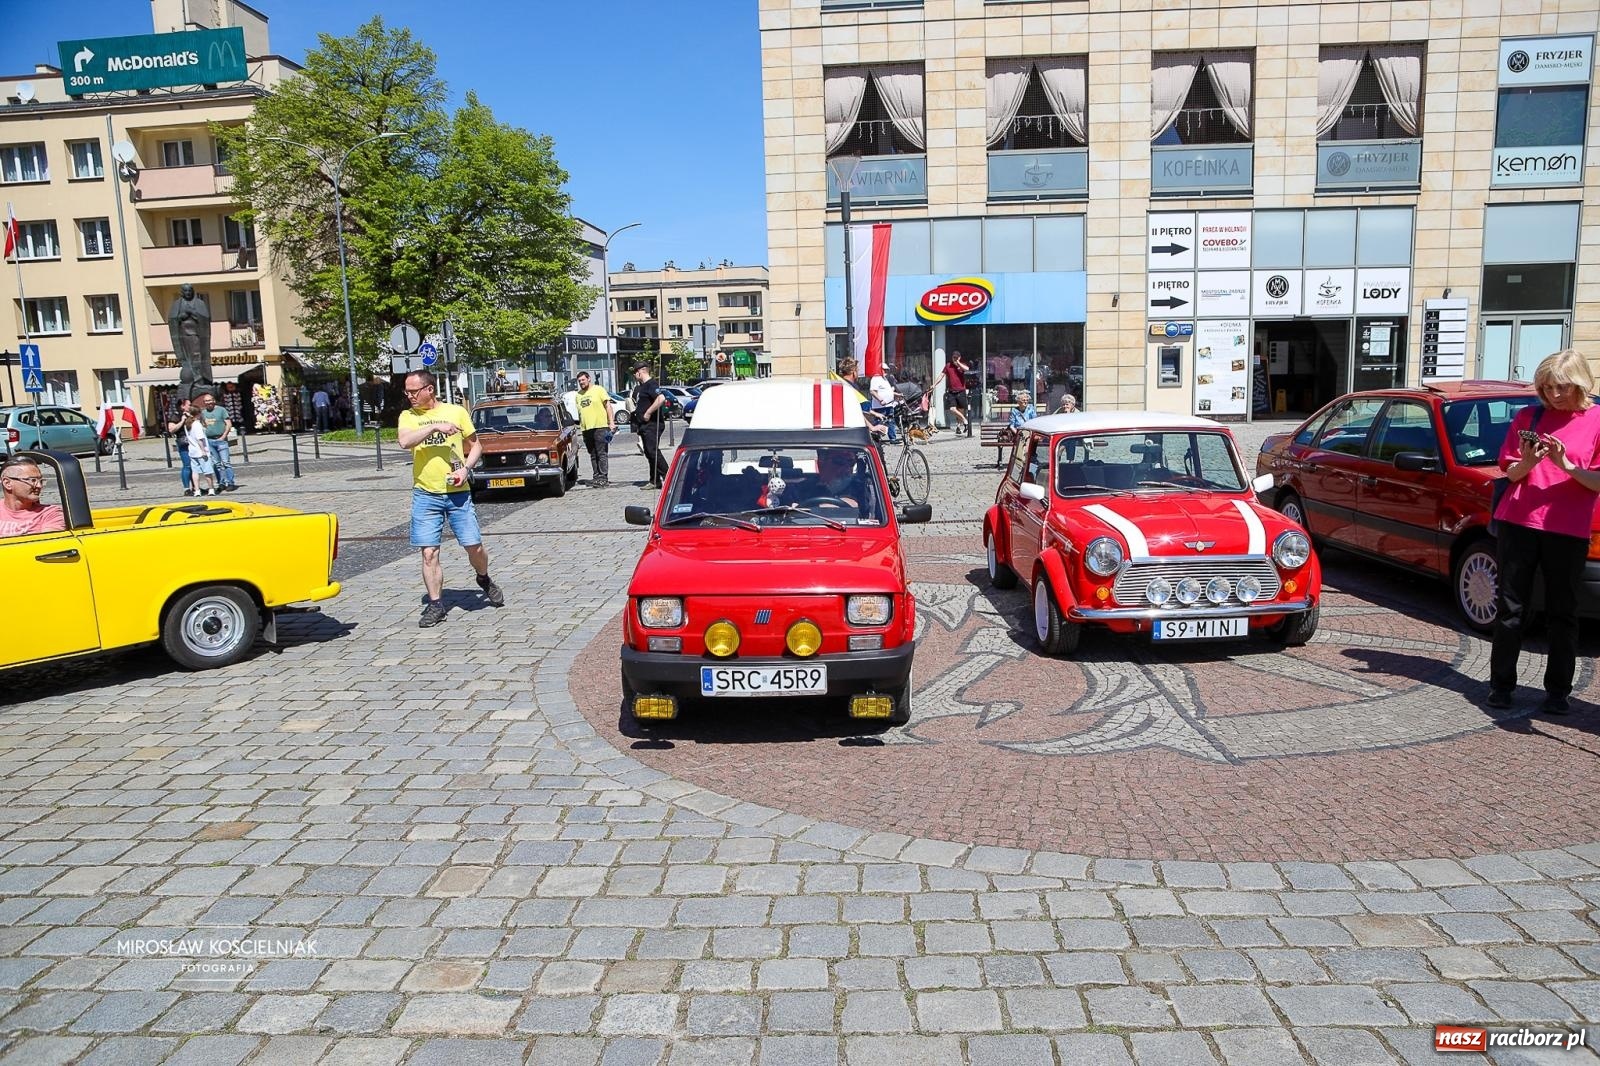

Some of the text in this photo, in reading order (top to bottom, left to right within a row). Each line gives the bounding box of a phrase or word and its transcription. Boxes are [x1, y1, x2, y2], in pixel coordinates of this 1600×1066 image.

[1536, 50, 1583, 60] FRYZJER
[107, 51, 199, 72] McDonald's
[70, 76, 104, 86] 300 m
[1356, 152, 1409, 164] FRYZJER
[1163, 159, 1240, 177] KOFEINKA
[1160, 227, 1192, 237] PIĘTRO
[1202, 238, 1239, 247] COVEBO
[1158, 280, 1190, 291] PIĘTRO
[928, 292, 982, 306] PEPCO
[1363, 287, 1401, 299] LODY
[571, 338, 595, 350] STUDIO
[1166, 619, 1238, 638] S9 MINI
[716, 669, 821, 690] SRC 45R9
